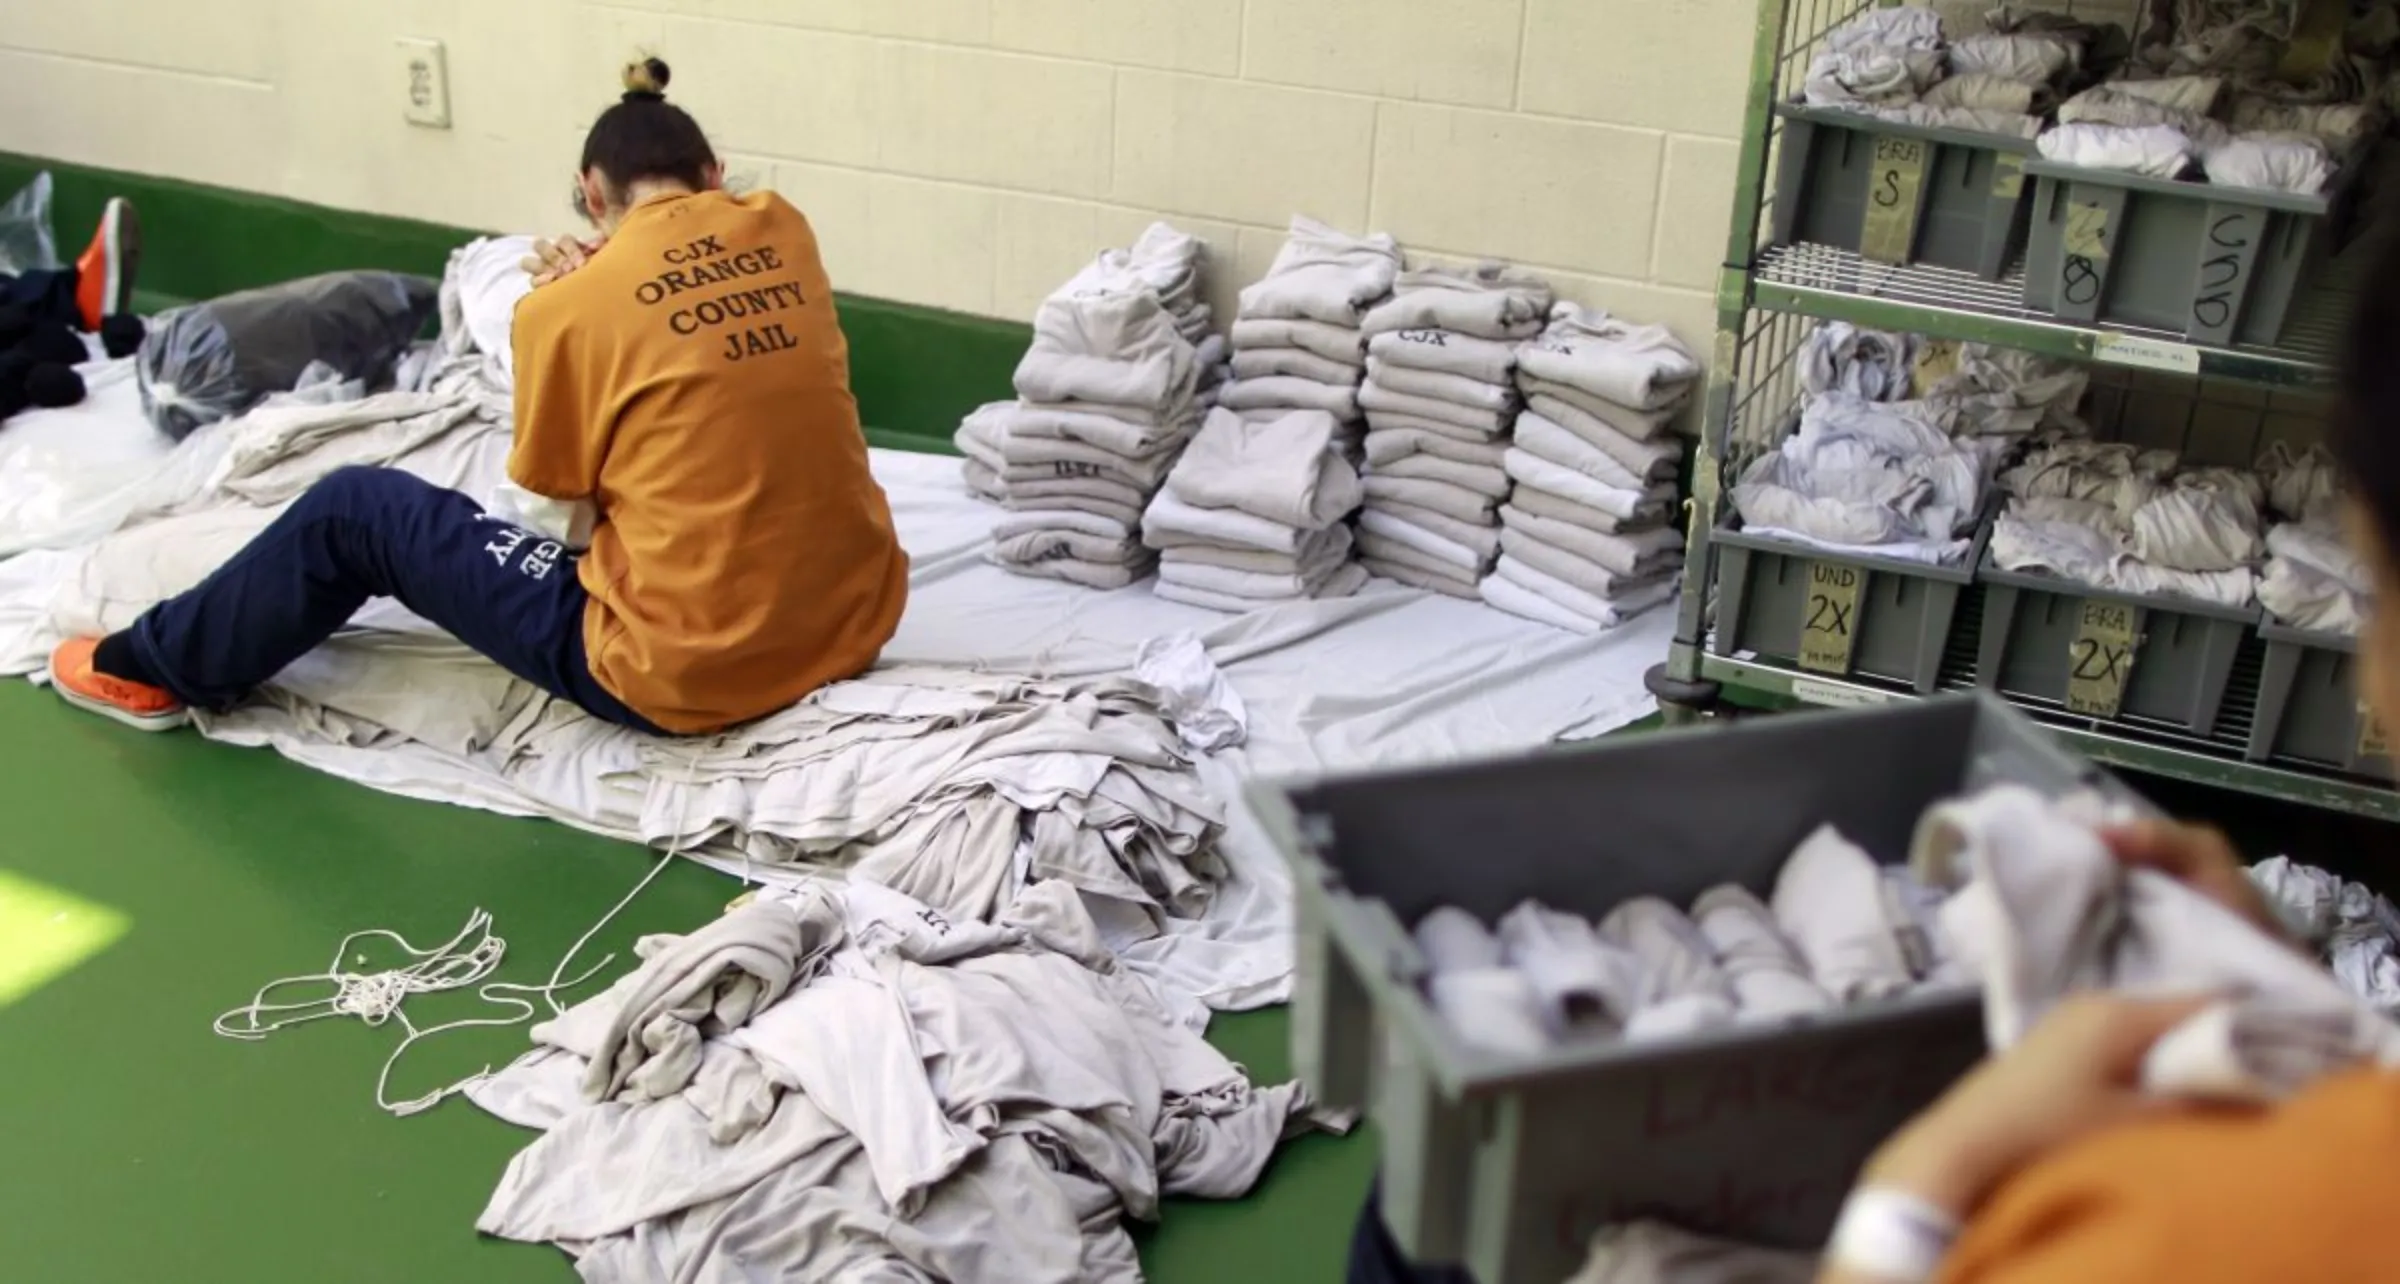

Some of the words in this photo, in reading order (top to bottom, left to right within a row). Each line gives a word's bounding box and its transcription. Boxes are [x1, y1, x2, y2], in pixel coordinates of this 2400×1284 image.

[1873, 168, 1900, 208] S
[663, 234, 727, 265] CJX
[634, 245, 785, 306] ORANGE
[668, 280, 807, 336] COUNTY
[723, 323, 799, 362] JAIL
[1814, 563, 1855, 588] UND
[1805, 593, 1852, 636] 2X
[2083, 604, 2126, 632] BRA
[2072, 637, 2126, 686] 2X
